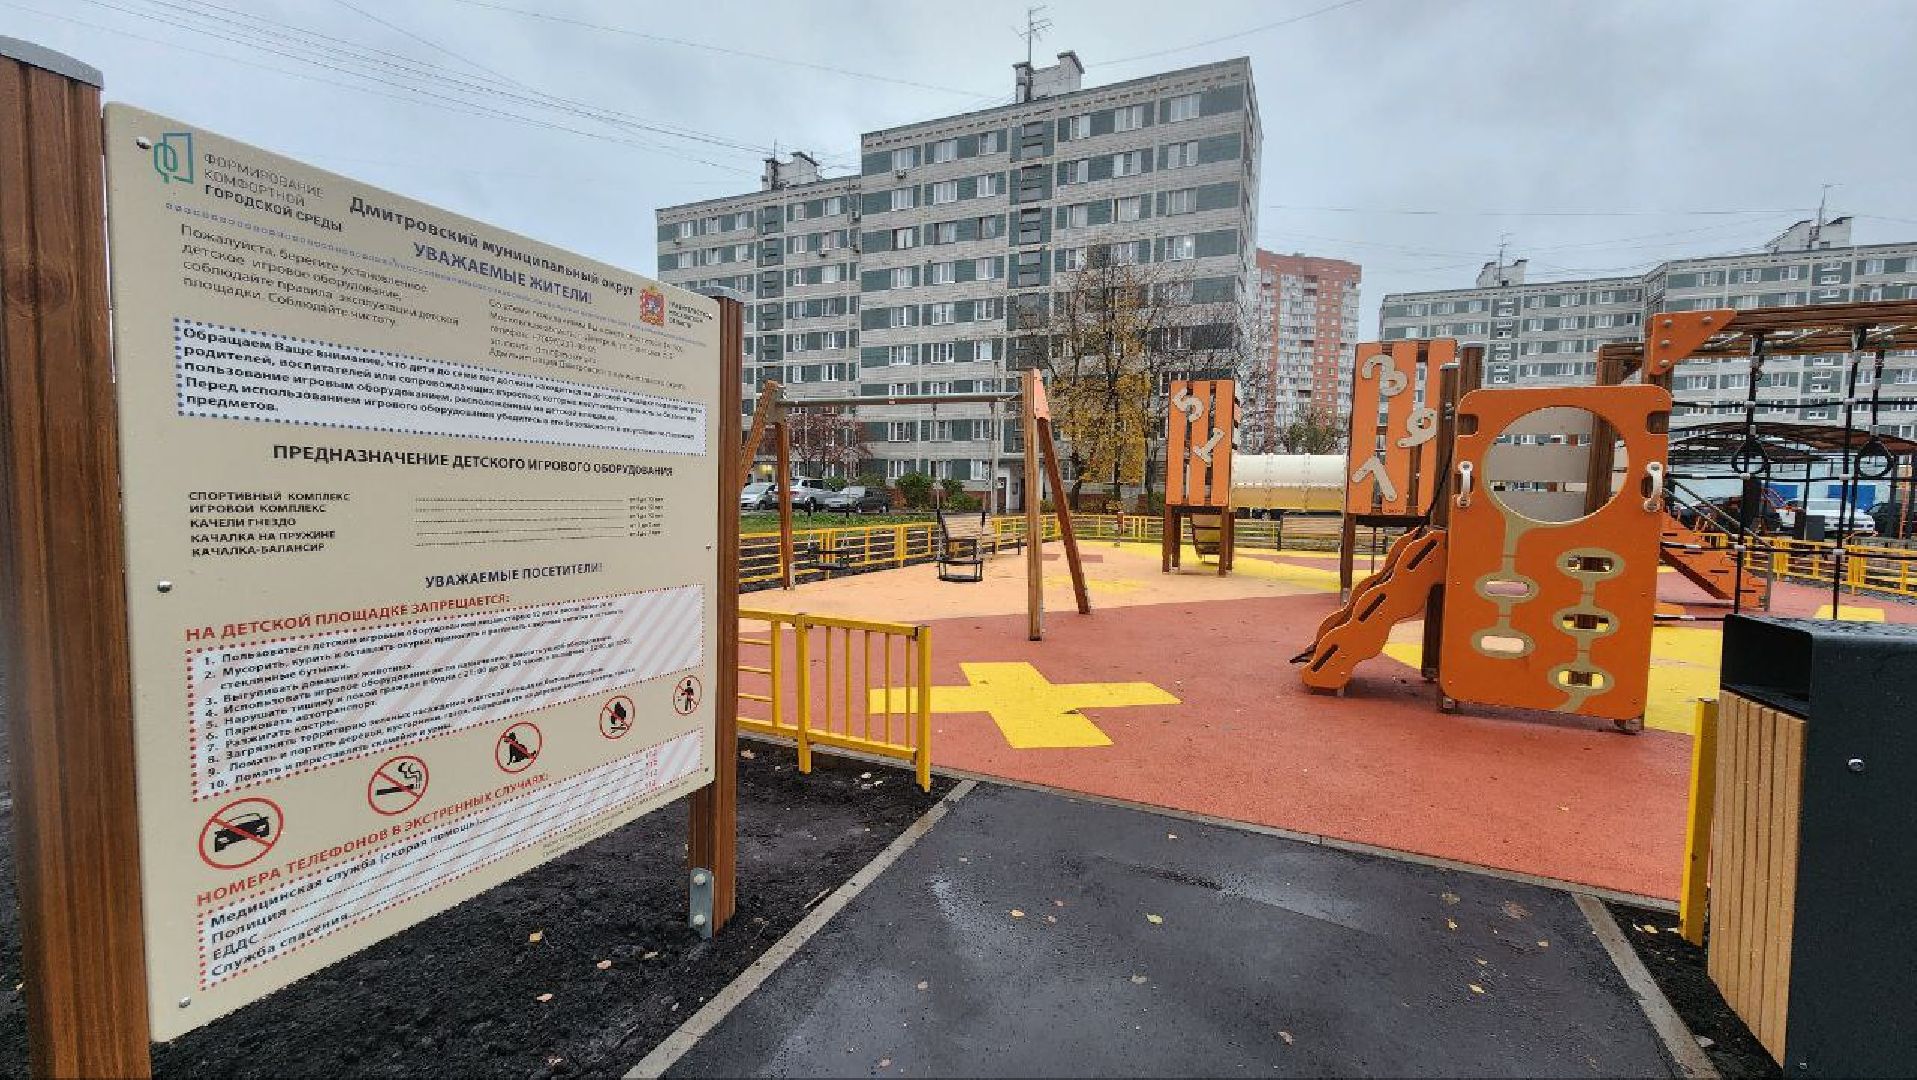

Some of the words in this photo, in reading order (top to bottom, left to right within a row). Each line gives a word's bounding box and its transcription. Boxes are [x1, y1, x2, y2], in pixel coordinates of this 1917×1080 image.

[204, 152, 324, 199] ФОРМИРОВАНИЕ
[204, 167, 305, 207] КОМФОРТНОЙ
[204, 182, 293, 218] ГОРОДСКОЙ
[295, 210, 342, 232] СРЕДЫ
[180, 223, 276, 259] Пожалуйста,
[278, 248, 338, 272] берегите
[181, 242, 244, 266] детское
[251, 258, 310, 281] игровое
[349, 194, 477, 250] Дмитровский
[482, 238, 598, 287] муниципальный
[601, 277, 633, 297] округ
[183, 258, 273, 288] соблюдайте
[277, 279, 332, 299] правила
[413, 241, 525, 286] УВАЖАЕМЫЕ
[529, 275, 591, 304] ЖИТЕЛИ!
[268, 292, 347, 317] Соблюдайте
[183, 327, 271, 350] Обращаем
[275, 342, 313, 355] Ваше
[315, 349, 383, 366] внимание,
[387, 361, 407, 369] что
[408, 364, 434, 374] дети
[436, 368, 450, 376] до
[479, 374, 494, 382] лет
[183, 345, 275, 367] родителей,
[279, 357, 371, 378] воспитателей
[374, 371, 396, 381] или
[398, 375, 494, 395] сопровождающих
[184, 361, 289, 382] пользование
[293, 375, 354, 390] игровым
[356, 382, 452, 402] оборудованием,
[1361, 354, 1408, 397] 3
[185, 377, 238, 393] Перед
[241, 384, 360, 405] использованием
[363, 398, 417, 411] игрового
[419, 404, 494, 419] оборудования
[186, 395, 278, 412] предметов.
[1171, 386, 1205, 423] 5
[273, 445, 449, 467] ПРЕДНАЗНАЧЕНИЕ
[452, 454, 525, 470] ДЕТСКОГО
[527, 459, 590, 472] ИГРОВОГО
[593, 463, 672, 476] ОБОРУДОВАНИЯ
[188, 491, 282, 500] СПОРТИВНЫЙ
[189, 519, 244, 528] КАЧЕЛИ
[247, 518, 296, 527] ГНЕЗДО
[190, 533, 255, 542] КАЧАЛКА
[279, 531, 336, 540] ПРУЖИНЕ
[191, 543, 325, 557] КАЧАЛКА-БАЛАНСИР
[425, 569, 519, 589] УВАЖАЕМЫЕ
[522, 562, 603, 579] ПОСЕТИТЕЛИ!
[185, 627, 216, 641] НА
[220, 613, 311, 638] ДЕТСКОЙ
[315, 605, 408, 627] ПЛОЩАДКЕ
[412, 592, 510, 614] ЗАПРЕЩАЕТСЯ:
[221, 642, 310, 662] Пользоваться
[312, 636, 357, 650] детским
[359, 630, 404, 643] игровым
[222, 659, 289, 678] Мусорить,
[291, 653, 332, 667] курить
[220, 671, 296, 690] стеклянные
[223, 682, 299, 703] Выгуливать
[301, 672, 358, 689] домашних
[223, 691, 311, 714] Использовать
[314, 683, 358, 697] игровое
[224, 706, 288, 726] Нарушать
[291, 698, 334, 713] тишину
[346, 688, 377, 700] покой
[224, 716, 293, 738] Парковать
[225, 737, 297, 761] Загрязнять
[300, 721, 367, 744] территорию
[290, 738, 337, 756] портить
[196, 866, 281, 907] НОМЕРА
[287, 829, 387, 873] ТЕЛЕФОНОВ
[392, 824, 402, 835] В
[404, 791, 492, 831] ЭКСТРЕННЫХ
[209, 877, 321, 929] Медицинская
[326, 857, 375, 884] служба
[380, 837, 427, 864] (скорая
[210, 906, 287, 946] Полиция
[211, 941, 276, 980] Служба
[280, 912, 348, 948] спасения
[212, 933, 258, 962] ЕДДС
